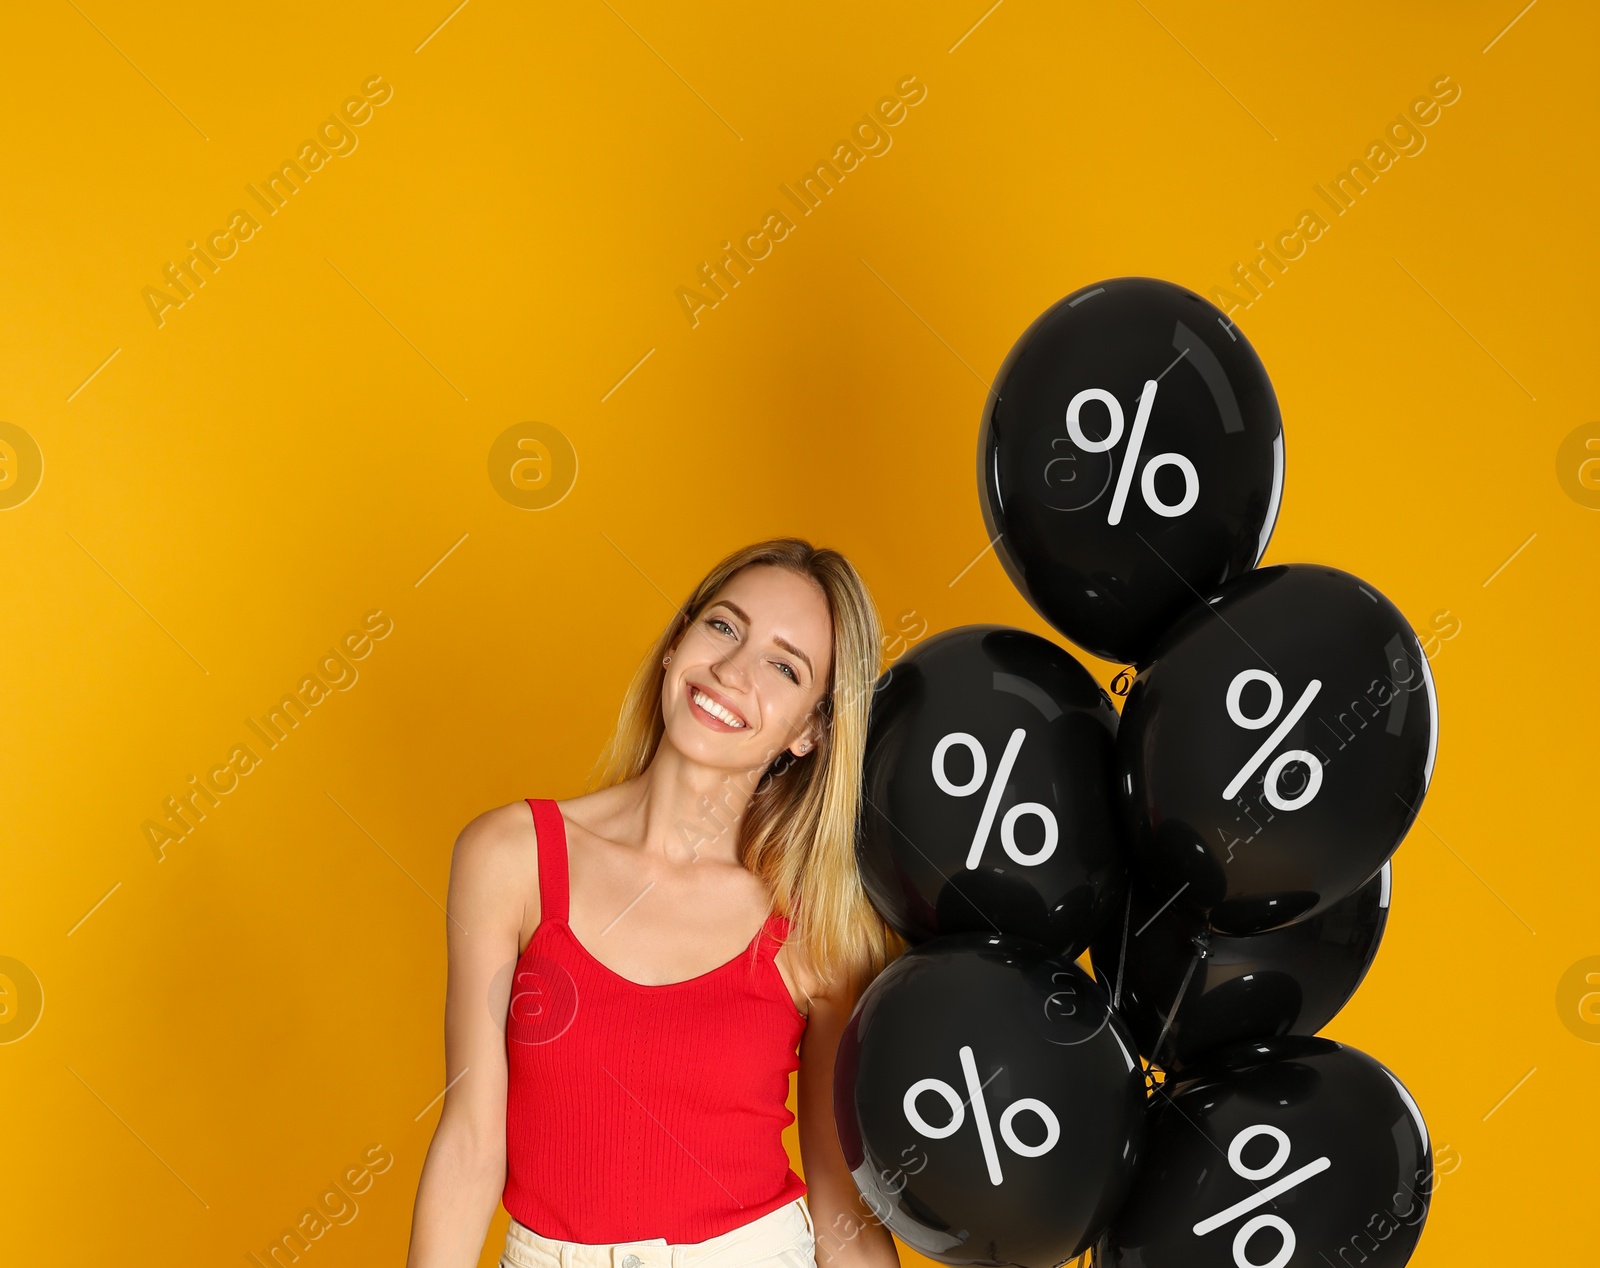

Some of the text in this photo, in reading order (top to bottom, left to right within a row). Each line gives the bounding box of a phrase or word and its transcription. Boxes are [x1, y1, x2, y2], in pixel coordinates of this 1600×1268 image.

[1066, 380, 1200, 526] %
[931, 728, 1059, 870] %
[1223, 669, 1323, 811] %
[904, 1045, 1061, 1186] %
